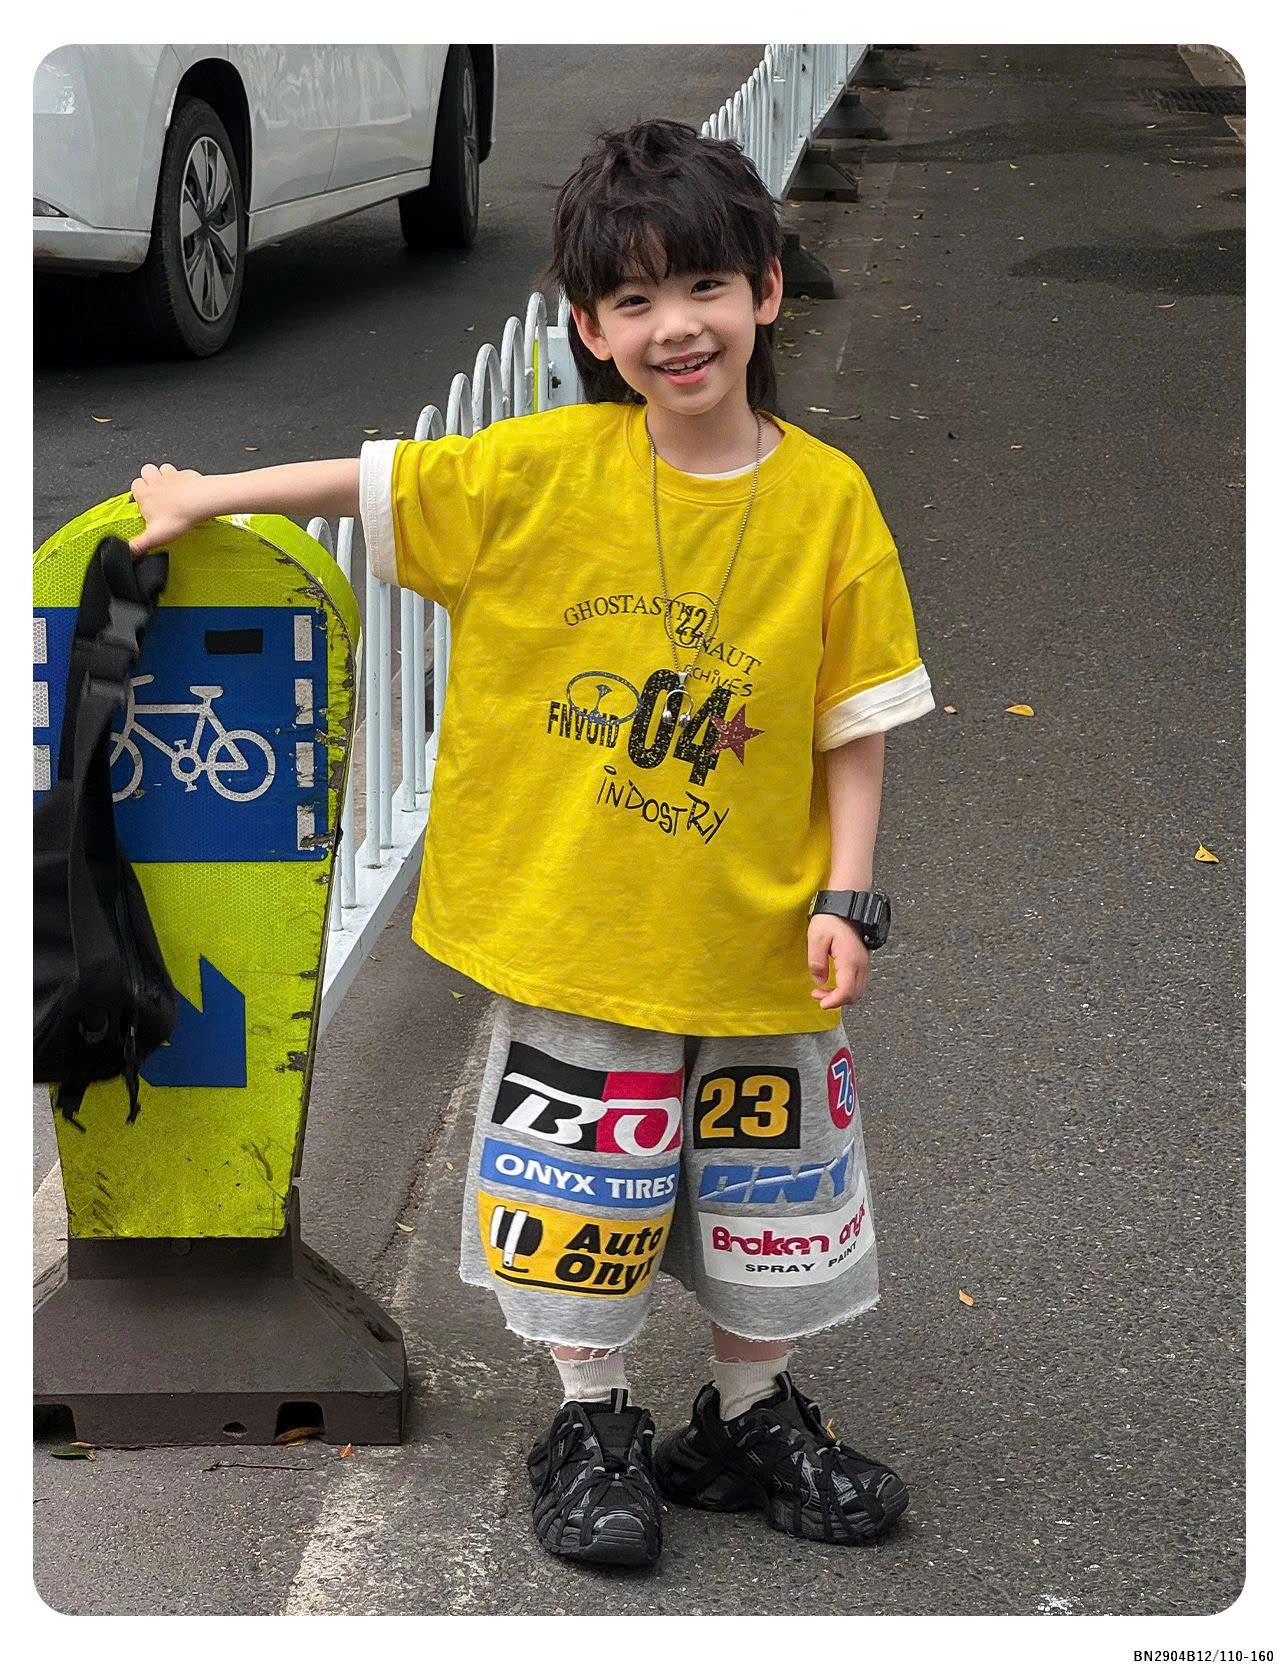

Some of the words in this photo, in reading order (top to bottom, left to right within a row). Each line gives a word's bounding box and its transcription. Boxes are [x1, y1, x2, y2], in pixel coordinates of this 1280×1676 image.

[628, 668, 732, 787] 04
[699, 1075, 791, 1139] 23
[831, 1057, 855, 1117] 76
[495, 1153, 596, 1196] ONYX
[605, 1172, 676, 1200] TIRES
[564, 1223, 664, 1257] Auto
[712, 1225, 830, 1257] Broken
[745, 1262, 816, 1273] SPRAY
[828, 1240, 857, 1268] PAINT
